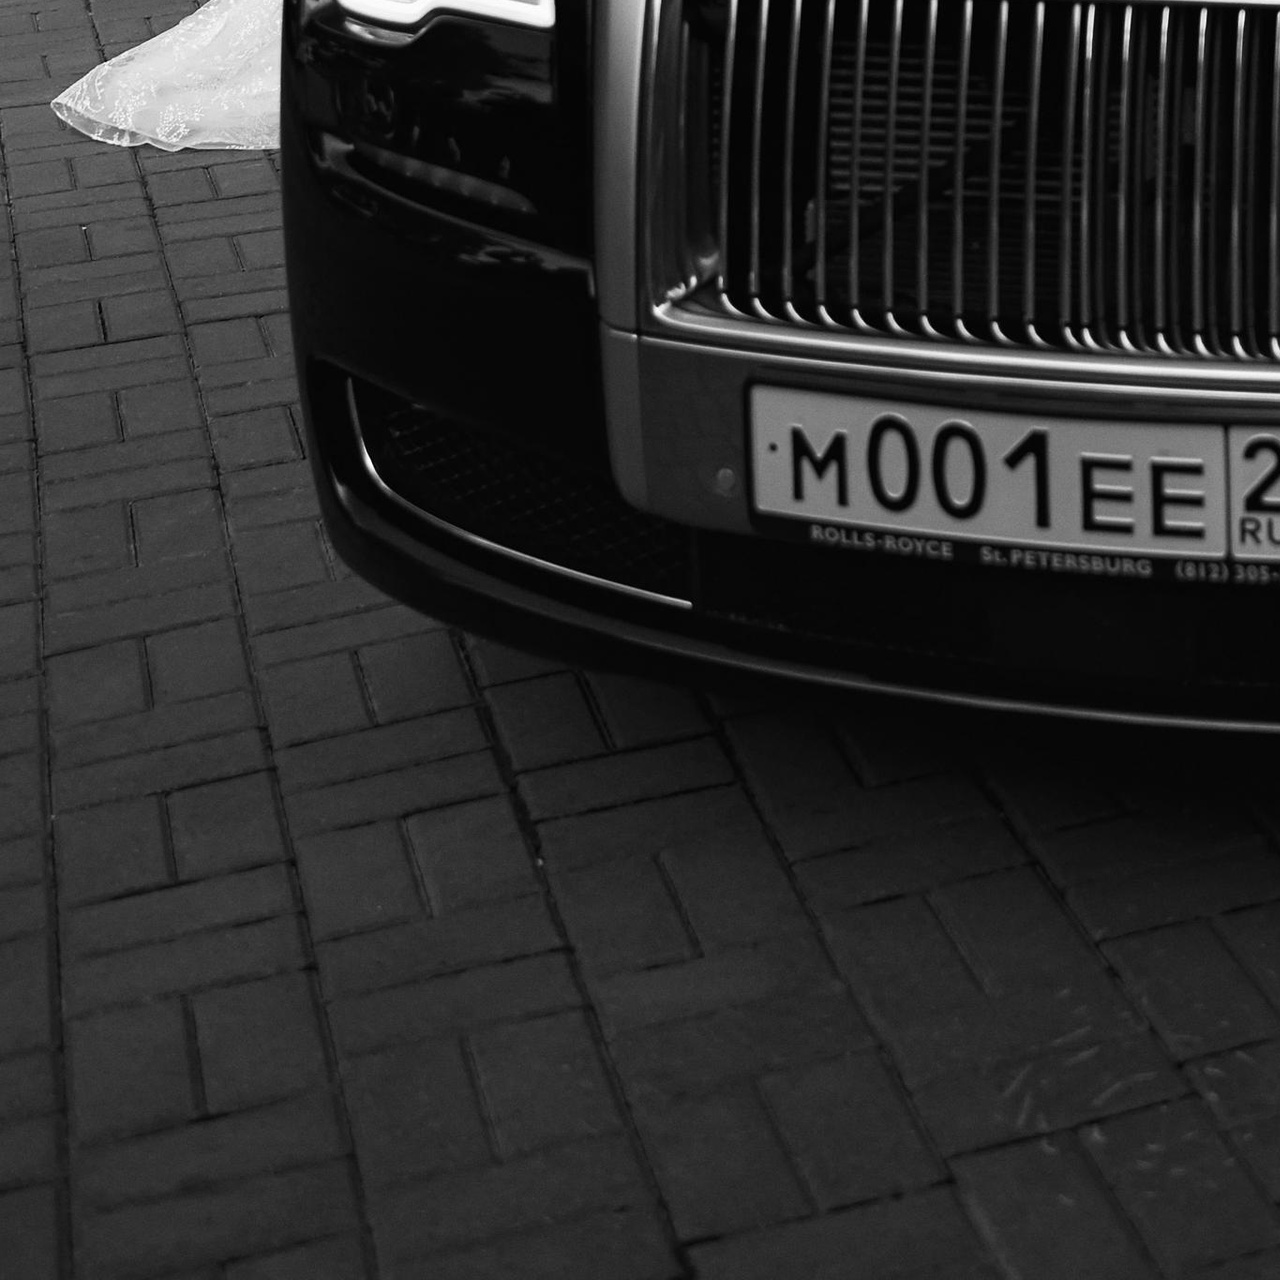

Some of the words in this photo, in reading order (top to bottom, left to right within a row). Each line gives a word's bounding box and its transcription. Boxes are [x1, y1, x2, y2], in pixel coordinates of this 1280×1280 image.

[791, 413, 1206, 539] M001EE
[810, 523, 954, 559] ROLLS-ROYCE
[1174, 558, 1230, 583] (812)
